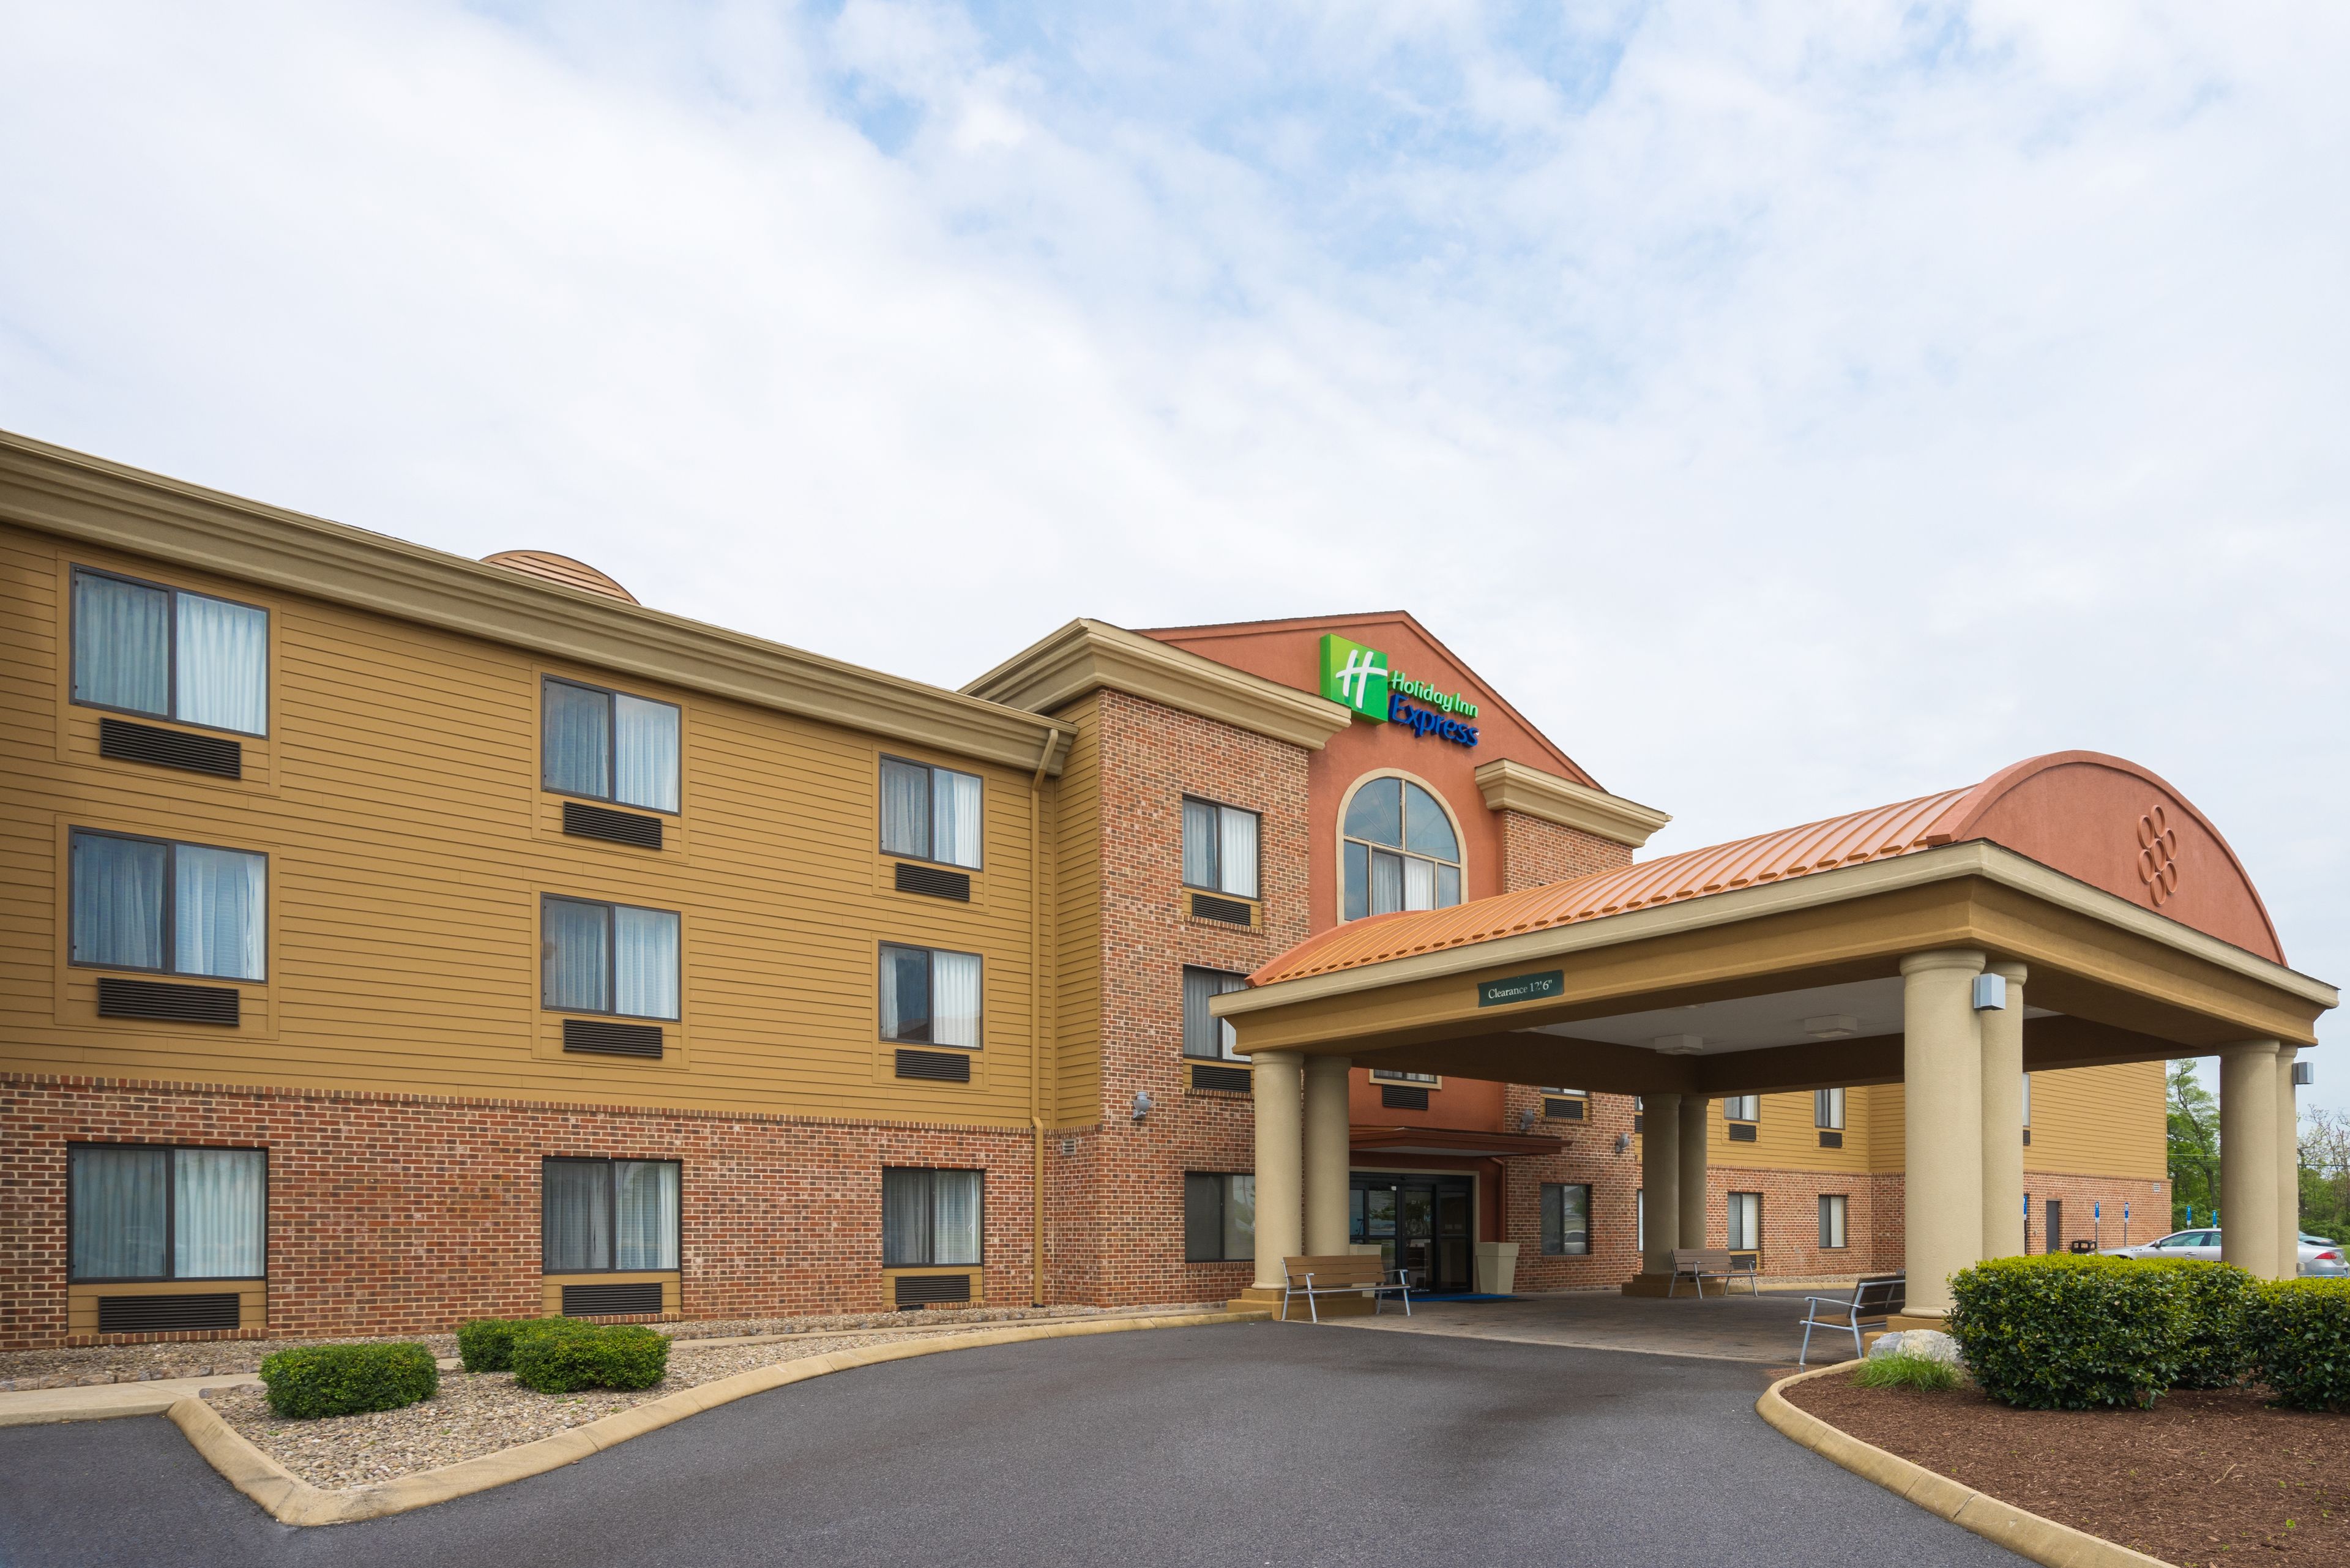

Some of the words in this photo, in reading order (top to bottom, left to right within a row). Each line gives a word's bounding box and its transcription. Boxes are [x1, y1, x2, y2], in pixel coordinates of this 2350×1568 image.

[1389, 670, 1453, 712] Holiday
[1453, 693, 1478, 719] Inn
[1389, 693, 1479, 747] Express
[1488, 986, 1528, 999] Clearance
